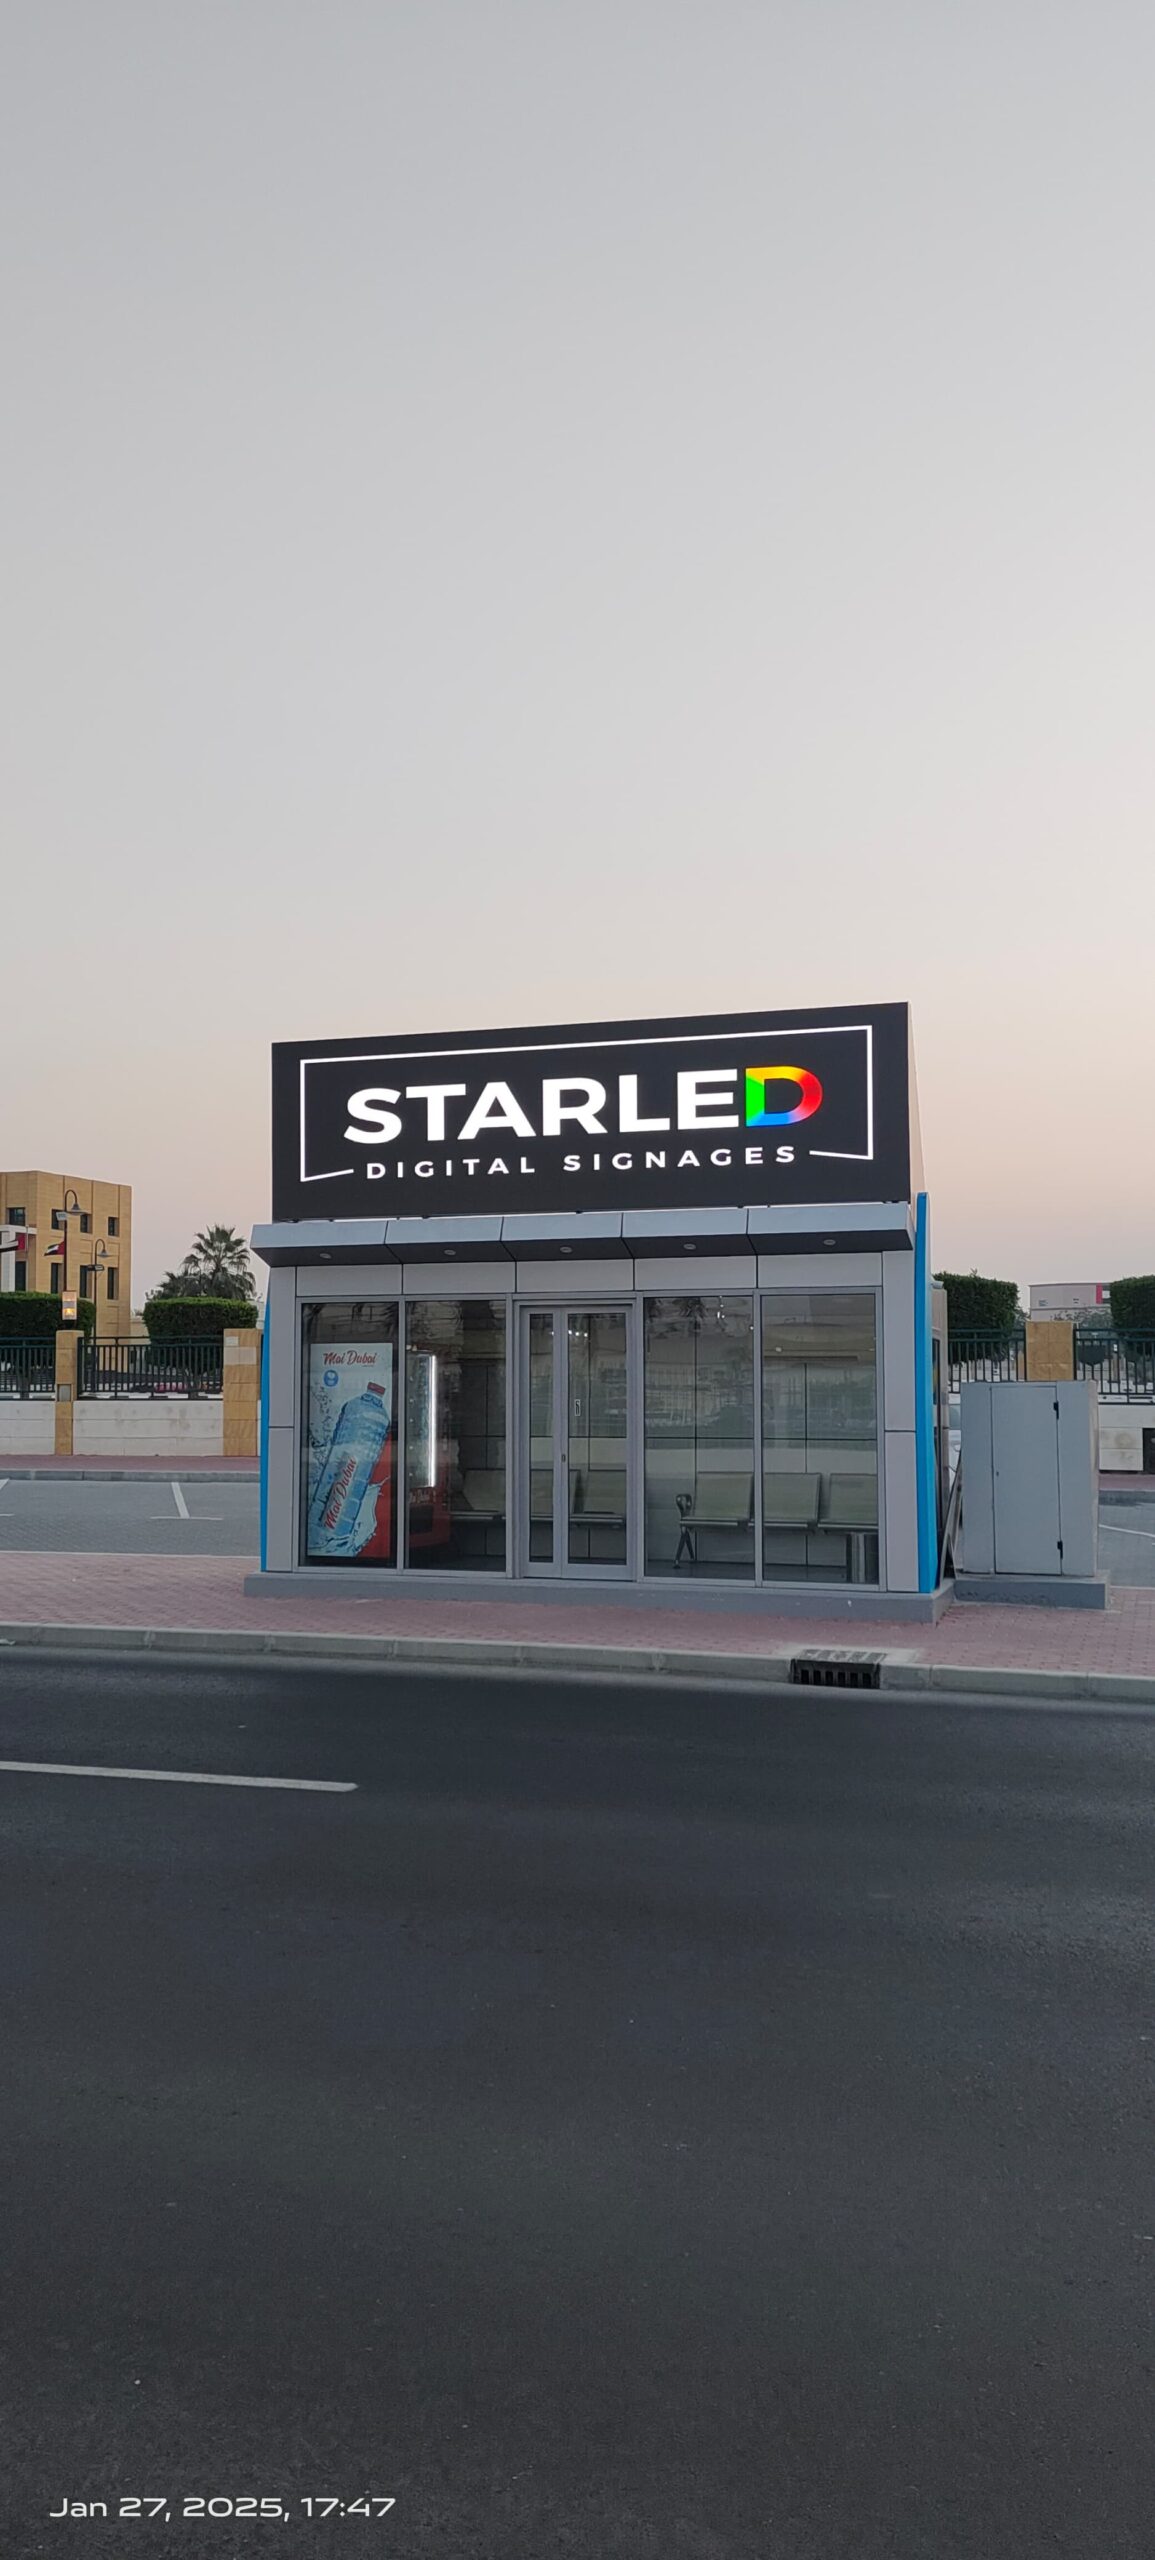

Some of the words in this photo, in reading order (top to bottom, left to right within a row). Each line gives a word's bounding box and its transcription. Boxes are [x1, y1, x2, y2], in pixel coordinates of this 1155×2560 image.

[343, 1065, 823, 1144] STARLED
[366, 1156, 536, 1179] DIGITAL
[563, 1146, 795, 1172] SIGNAGES
[323, 1352, 346, 1366] Mai
[346, 1350, 377, 1366] Dubai
[332, 1456, 357, 1500] Dubai
[324, 1500, 342, 1530] Mai
